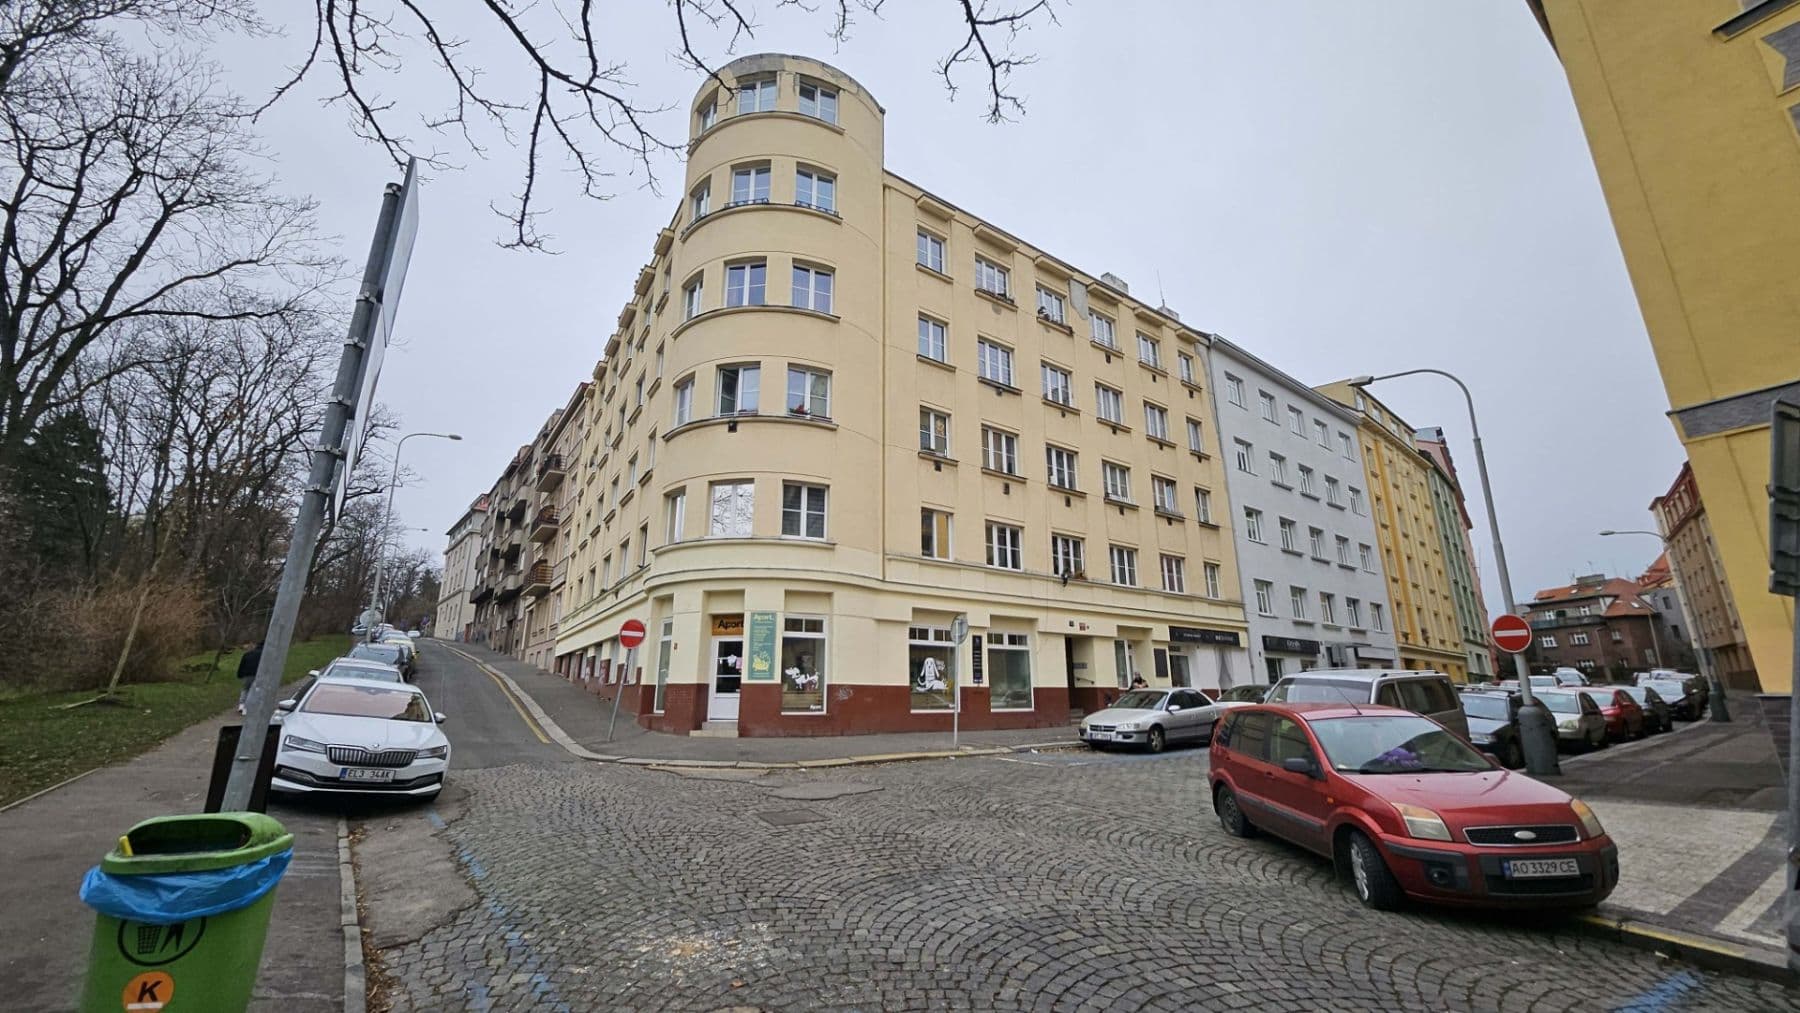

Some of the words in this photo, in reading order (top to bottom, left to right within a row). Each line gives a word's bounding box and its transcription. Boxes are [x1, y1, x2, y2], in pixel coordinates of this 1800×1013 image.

[1531, 862, 1557, 874] 3329
[1560, 861, 1577, 873] CE
[137, 980, 163, 1002] K
